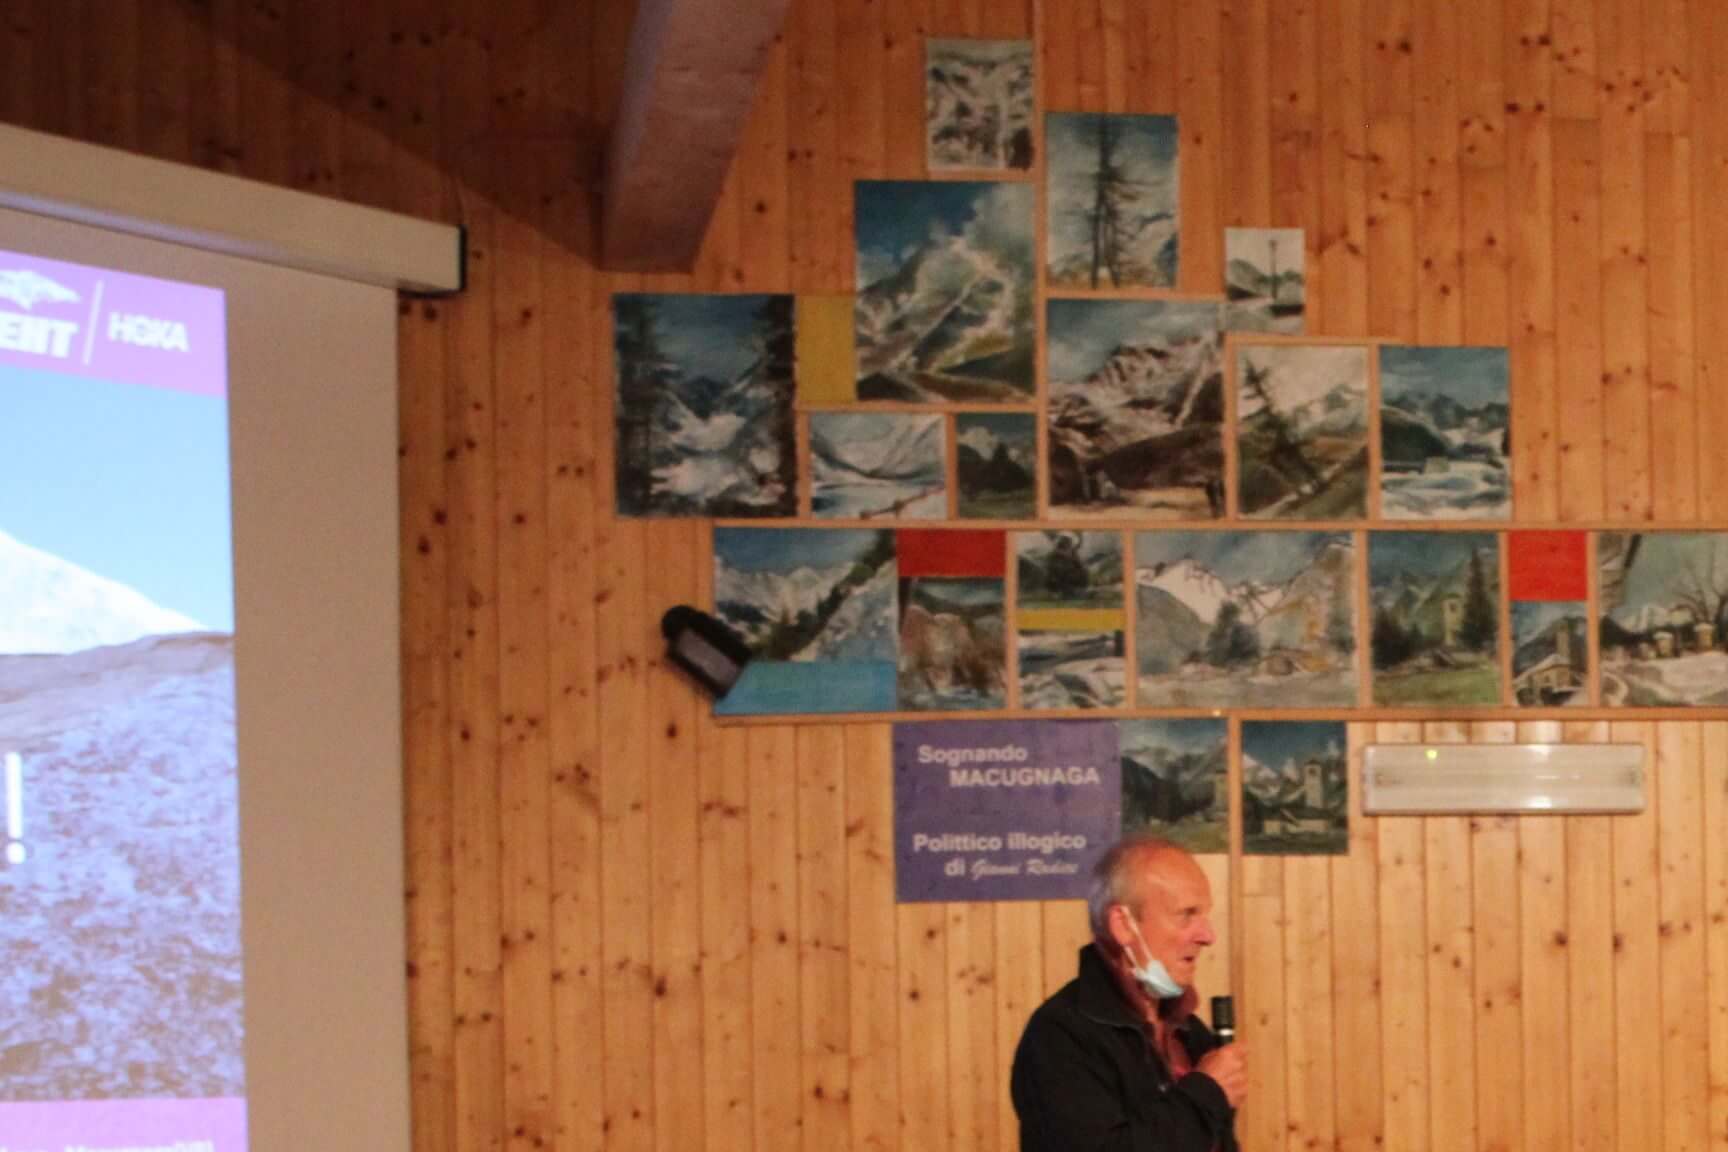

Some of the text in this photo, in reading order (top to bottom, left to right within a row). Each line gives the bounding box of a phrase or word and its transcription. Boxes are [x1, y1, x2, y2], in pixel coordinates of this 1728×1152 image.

[107, 311, 192, 353] HOKA
[917, 744, 1028, 766] Sognando
[949, 766, 1101, 787] MACUGNAGA
[912, 832, 1002, 852] Polittico
[943, 857, 966, 876] di
